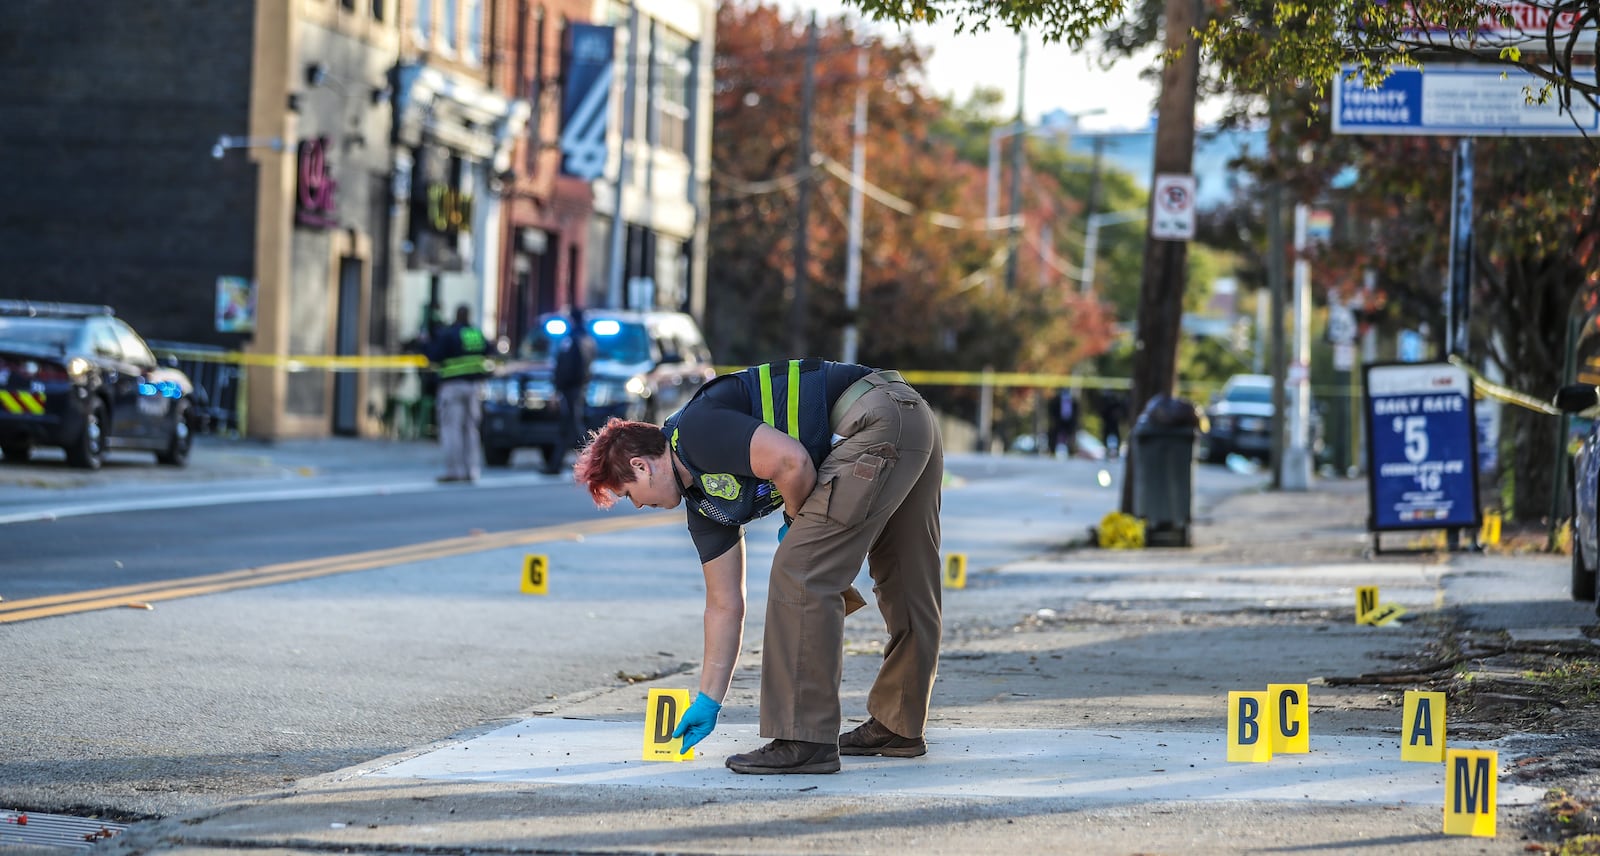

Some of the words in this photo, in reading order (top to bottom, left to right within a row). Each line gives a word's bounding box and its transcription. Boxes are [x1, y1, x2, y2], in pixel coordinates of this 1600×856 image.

[1343, 90, 1407, 106] TRINITY
[1343, 106, 1410, 123] AVENUE
[1374, 398, 1420, 415] DAILY
[1423, 396, 1463, 413] RATE
[530, 558, 543, 586] G
[1361, 589, 1374, 617] N
[654, 695, 677, 743] D
[1238, 697, 1259, 745] B
[1279, 689, 1299, 737] C
[1410, 698, 1433, 746] A
[1454, 757, 1489, 814] M
